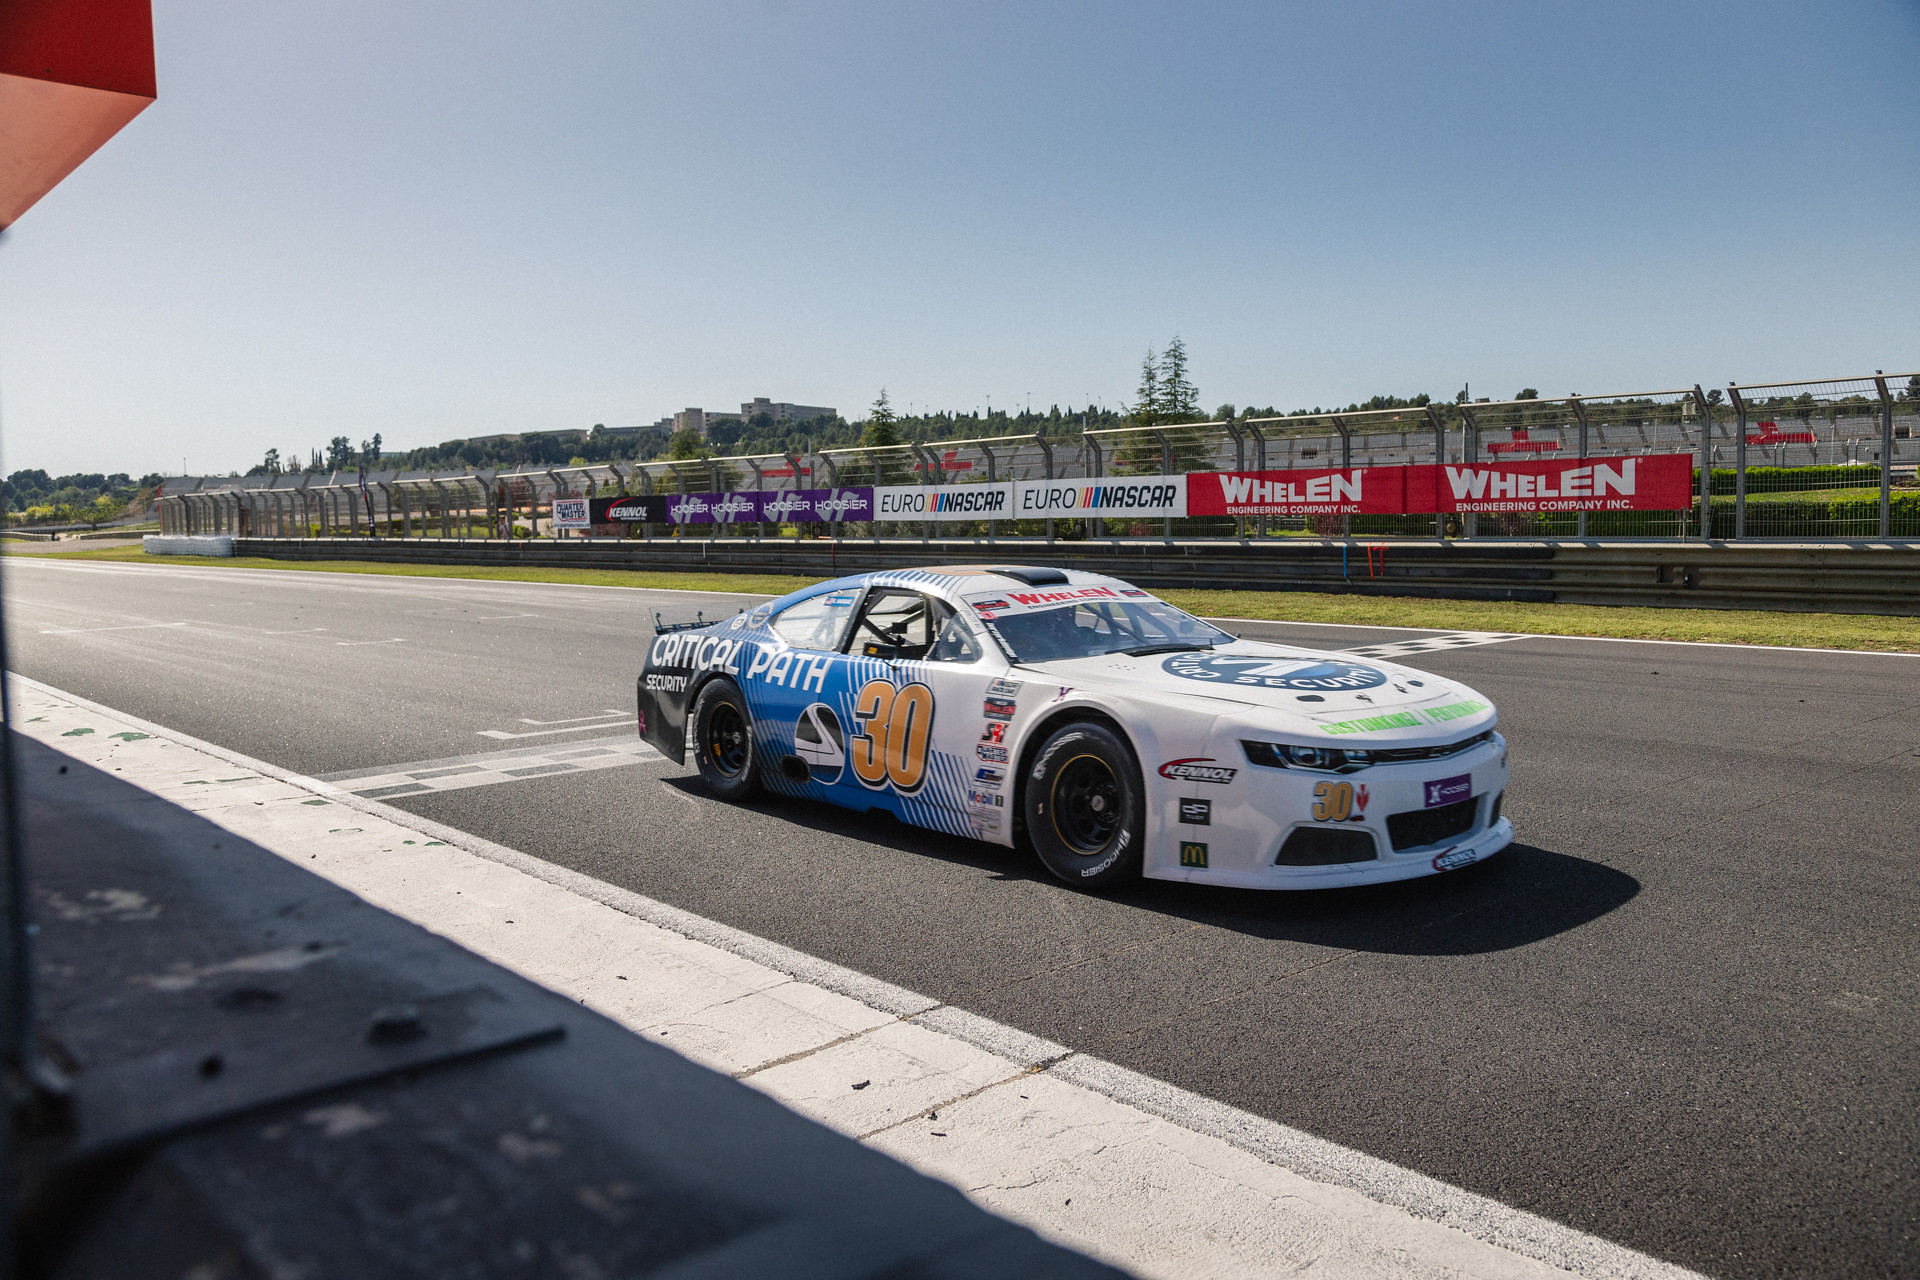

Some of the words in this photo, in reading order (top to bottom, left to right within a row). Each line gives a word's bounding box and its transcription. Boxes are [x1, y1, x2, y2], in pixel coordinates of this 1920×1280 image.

[1218, 469, 1362, 503] WHELEN
[1445, 458, 1636, 500] WHELEN
[814, 499, 868, 511] HOOSIER
[881, 493, 925, 513] EURO
[943, 490, 1005, 512] NASCAR
[1023, 487, 1077, 509] EURO
[1098, 484, 1176, 508] NASCAR
[557, 502, 584, 513] QUARTER
[608, 506, 648, 518] KENNOL
[670, 504, 708, 514] HOOSIER
[711, 502, 754, 513] HOOSIER
[763, 500, 811, 512] HOOSIER
[1226, 505, 1288, 515] ENGINEERING
[1290, 504, 1339, 514] COMPANY
[1340, 504, 1361, 513] INC.
[1455, 502, 1536, 512] ENGINEERING
[1539, 500, 1603, 511] COMPANY
[1607, 499, 1634, 510] INC.
[562, 510, 585, 519] MASTER
[1006, 586, 1118, 606] WHELEN
[651, 634, 744, 676] CRITICAL
[746, 650, 834, 694] PATH
[646, 674, 687, 693] SECURITY
[1234, 667, 1376, 688] SECURITY
[851, 678, 935, 796] 30
[1163, 764, 1234, 780] KENNOL
[968, 789, 993, 805] Mobil
[1312, 781, 1354, 822] 30
[1081, 843, 1124, 877] HOOSIER
